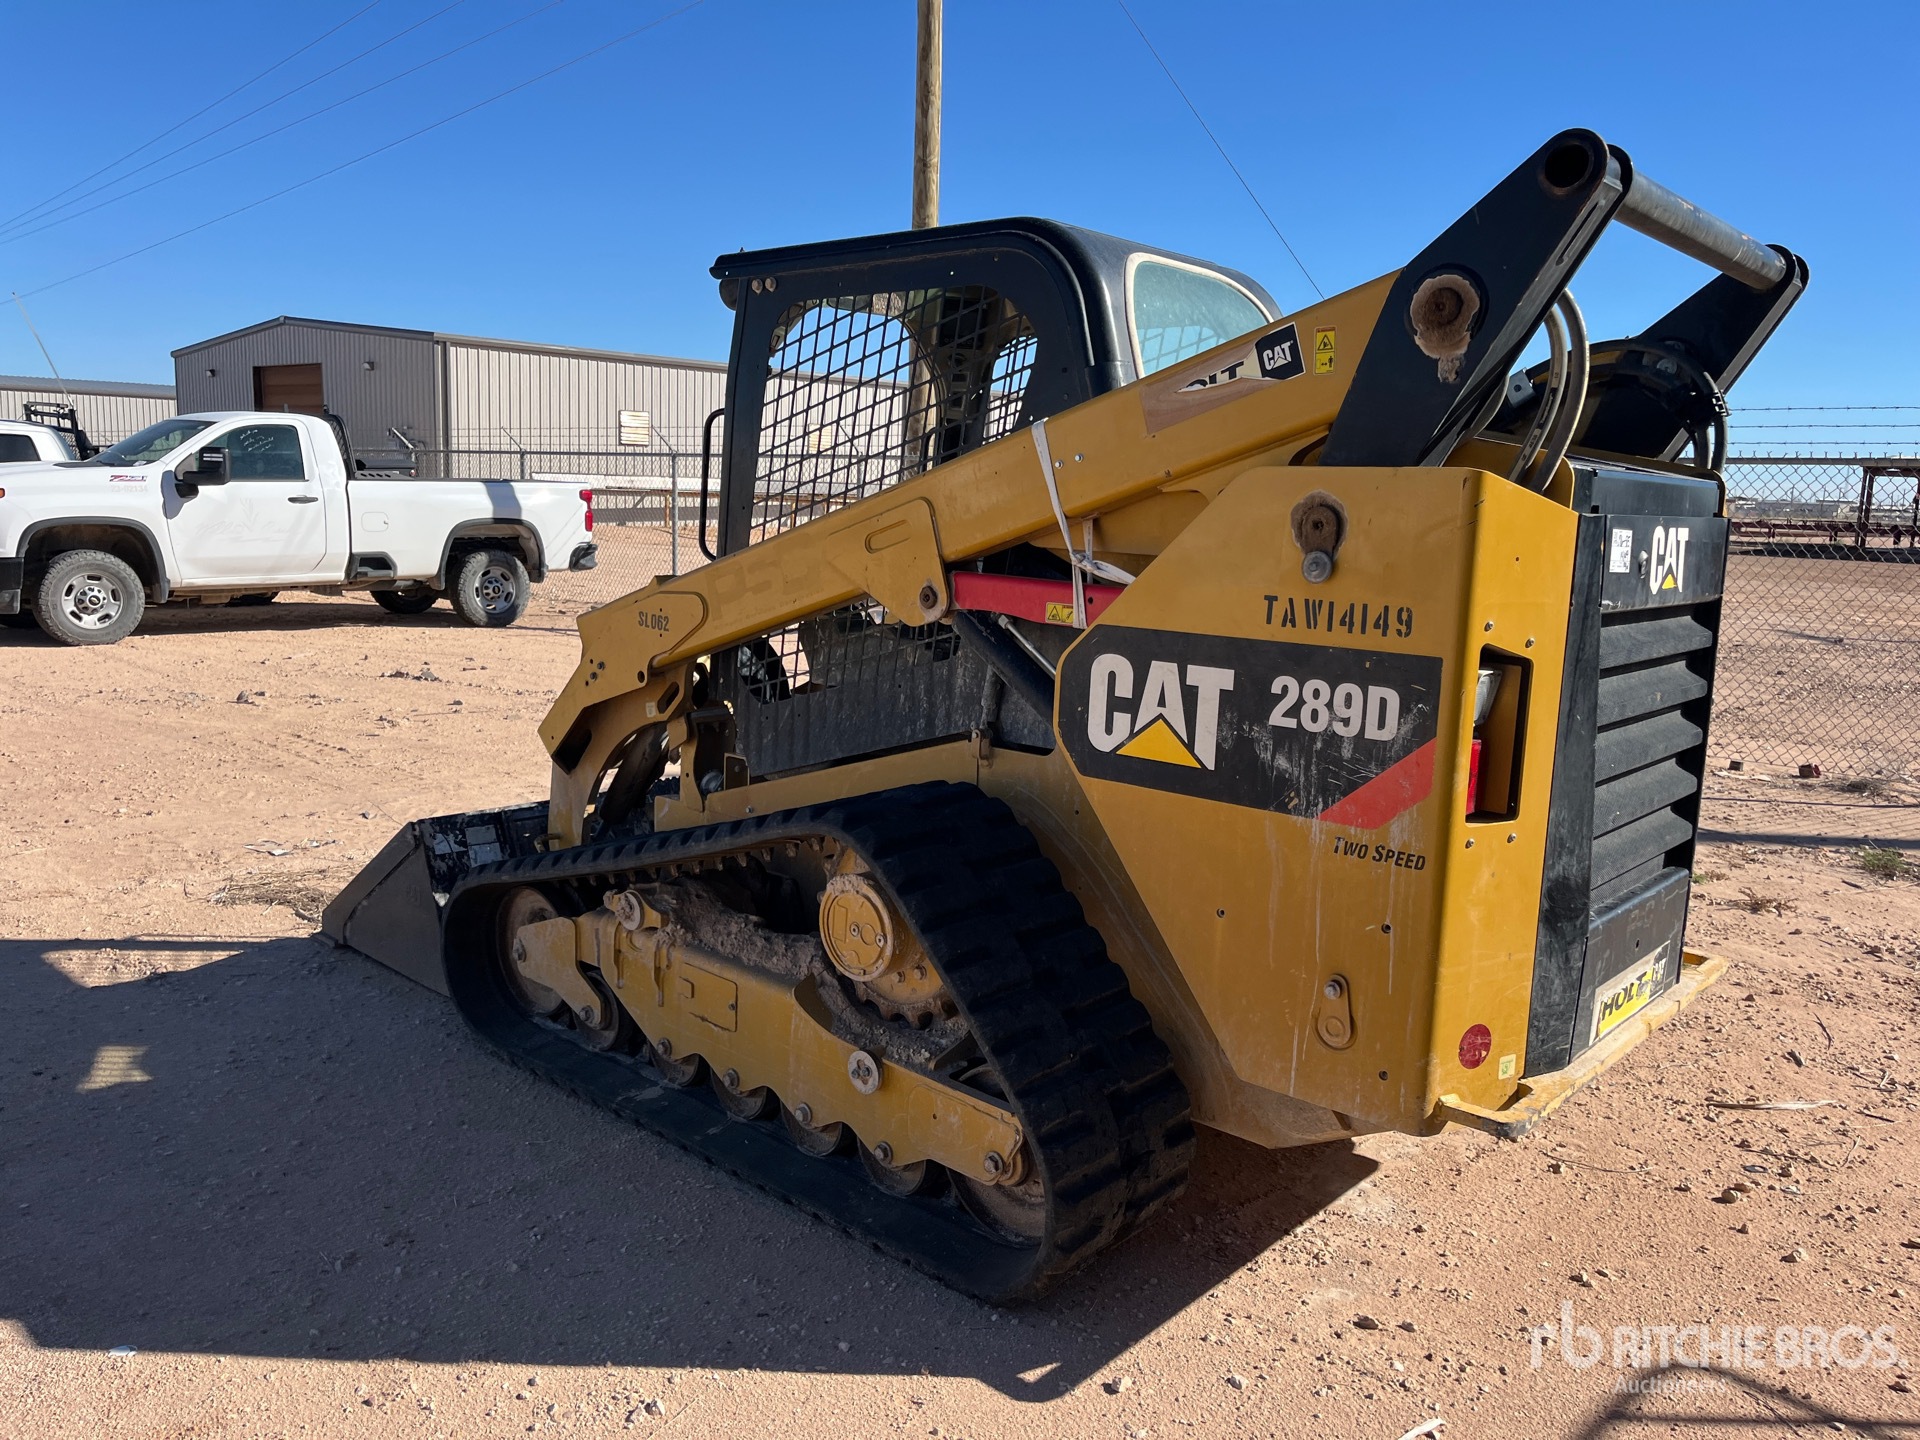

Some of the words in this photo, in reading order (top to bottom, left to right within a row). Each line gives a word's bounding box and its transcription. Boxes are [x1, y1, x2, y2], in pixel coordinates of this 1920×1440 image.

[1263, 341, 1292, 371] CAT
[1650, 525, 1689, 595] CAT
[637, 611, 670, 632] SL062
[1263, 594, 1414, 639] TAW14149
[1087, 653, 1235, 771] CAT
[1268, 675, 1401, 742] 289D
